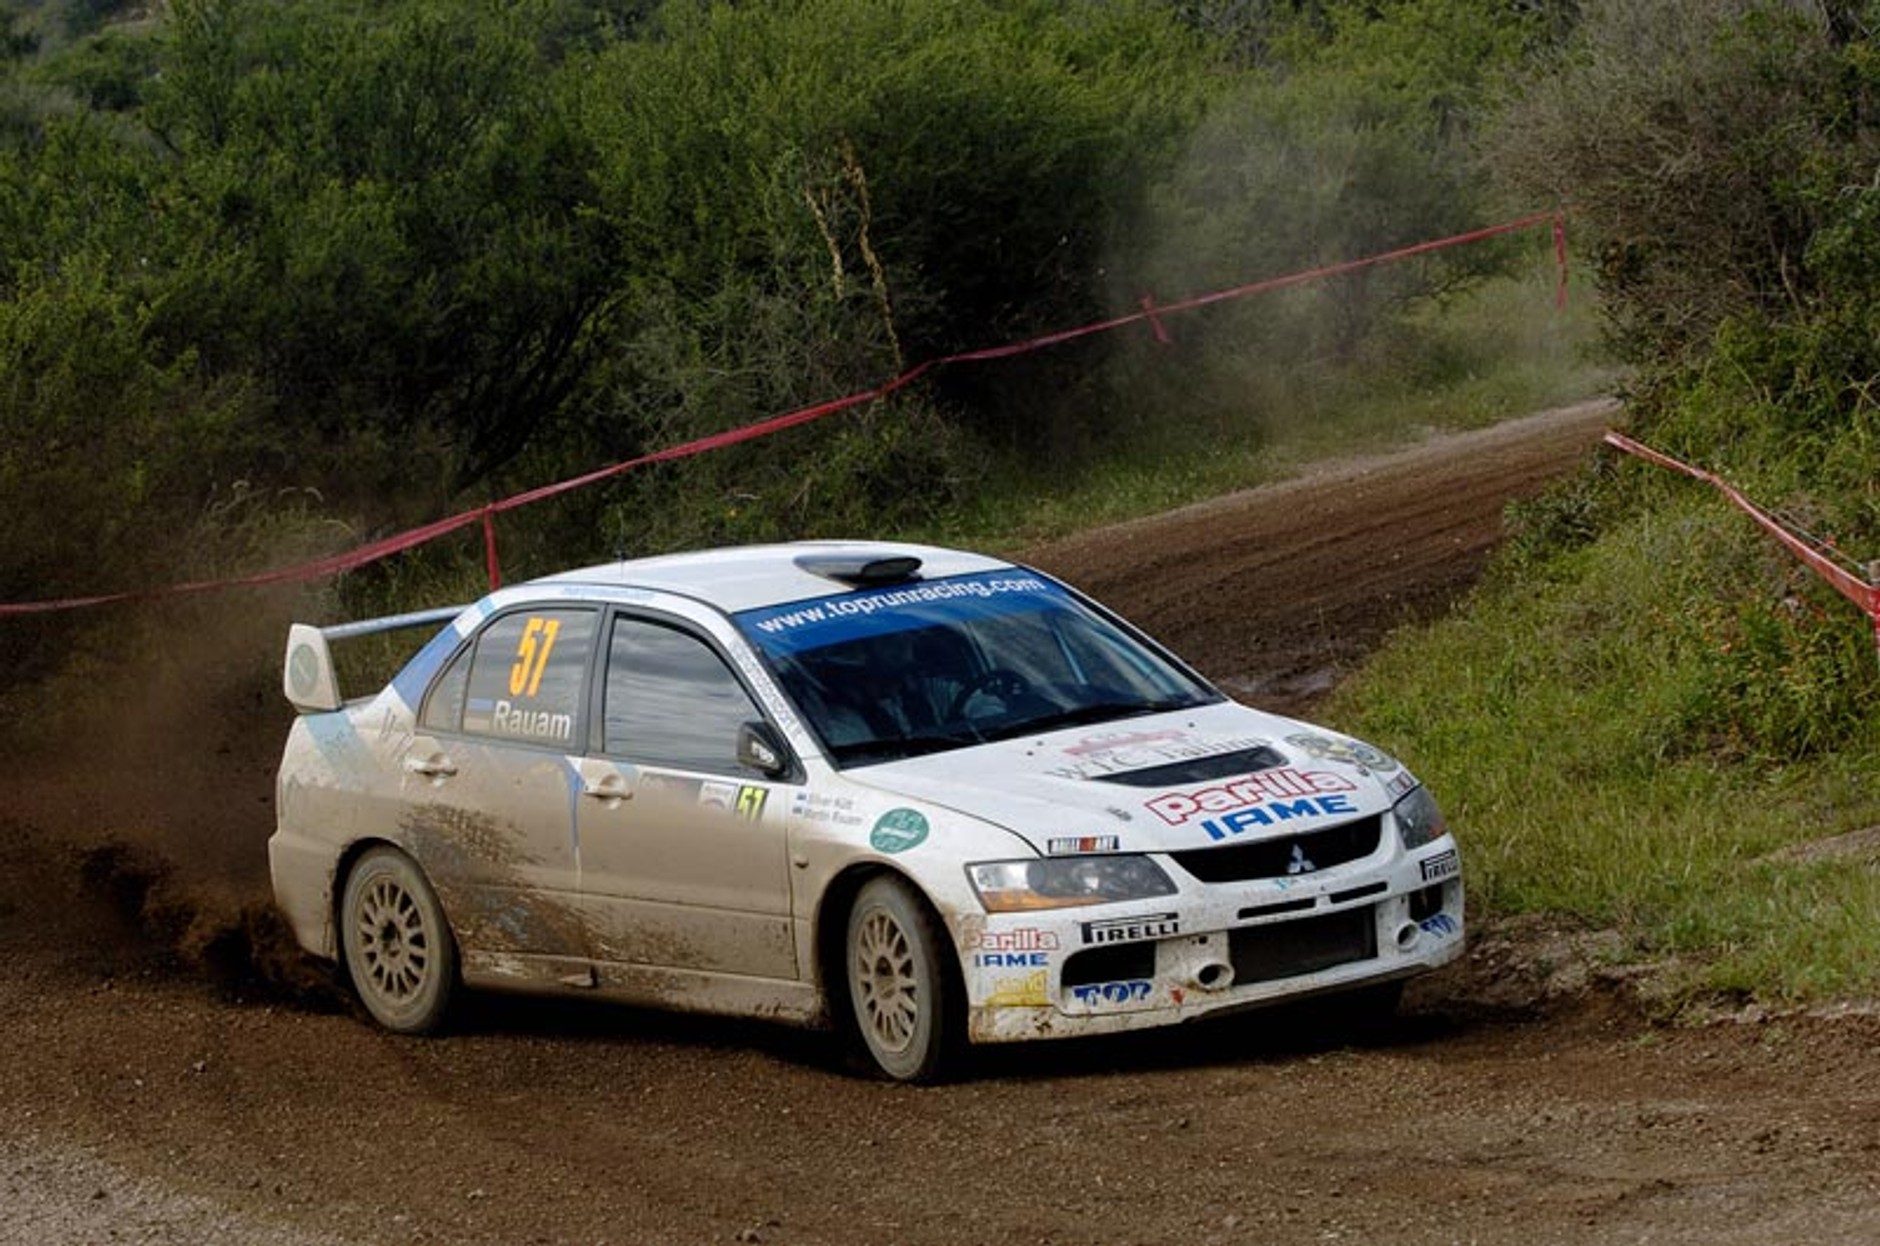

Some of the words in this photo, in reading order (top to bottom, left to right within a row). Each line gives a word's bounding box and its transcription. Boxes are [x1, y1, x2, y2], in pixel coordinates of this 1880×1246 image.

[756, 576, 1046, 634] www.toprunracing.com
[509, 617, 560, 697] 57
[493, 699, 571, 741] Rauam
[738, 786, 766, 822] 57
[1145, 768, 1357, 826] Parilla
[1201, 794, 1358, 841] IAME
[963, 927, 1060, 951] Parilla
[1081, 913, 1178, 944] PIRELLI
[975, 952, 1049, 968] IAME
